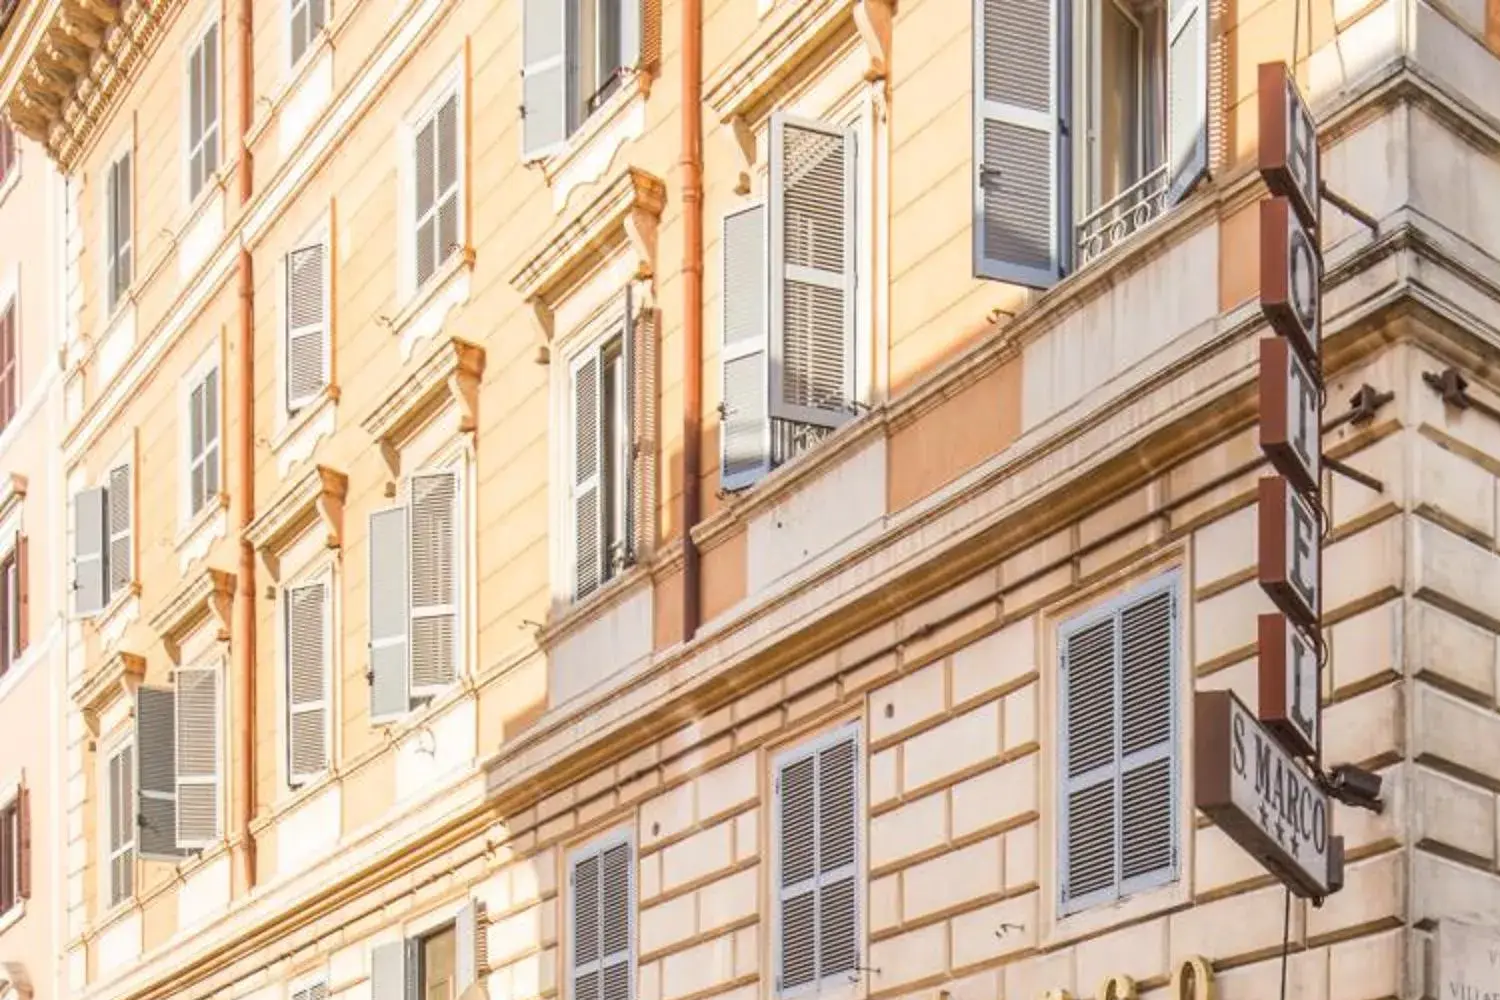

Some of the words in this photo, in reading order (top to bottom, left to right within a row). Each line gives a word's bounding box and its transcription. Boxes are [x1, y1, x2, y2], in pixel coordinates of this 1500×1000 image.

[1287, 74, 1316, 742] HOTEL
[1233, 712, 1247, 780] S.
[1254, 733, 1326, 856] MARCO
